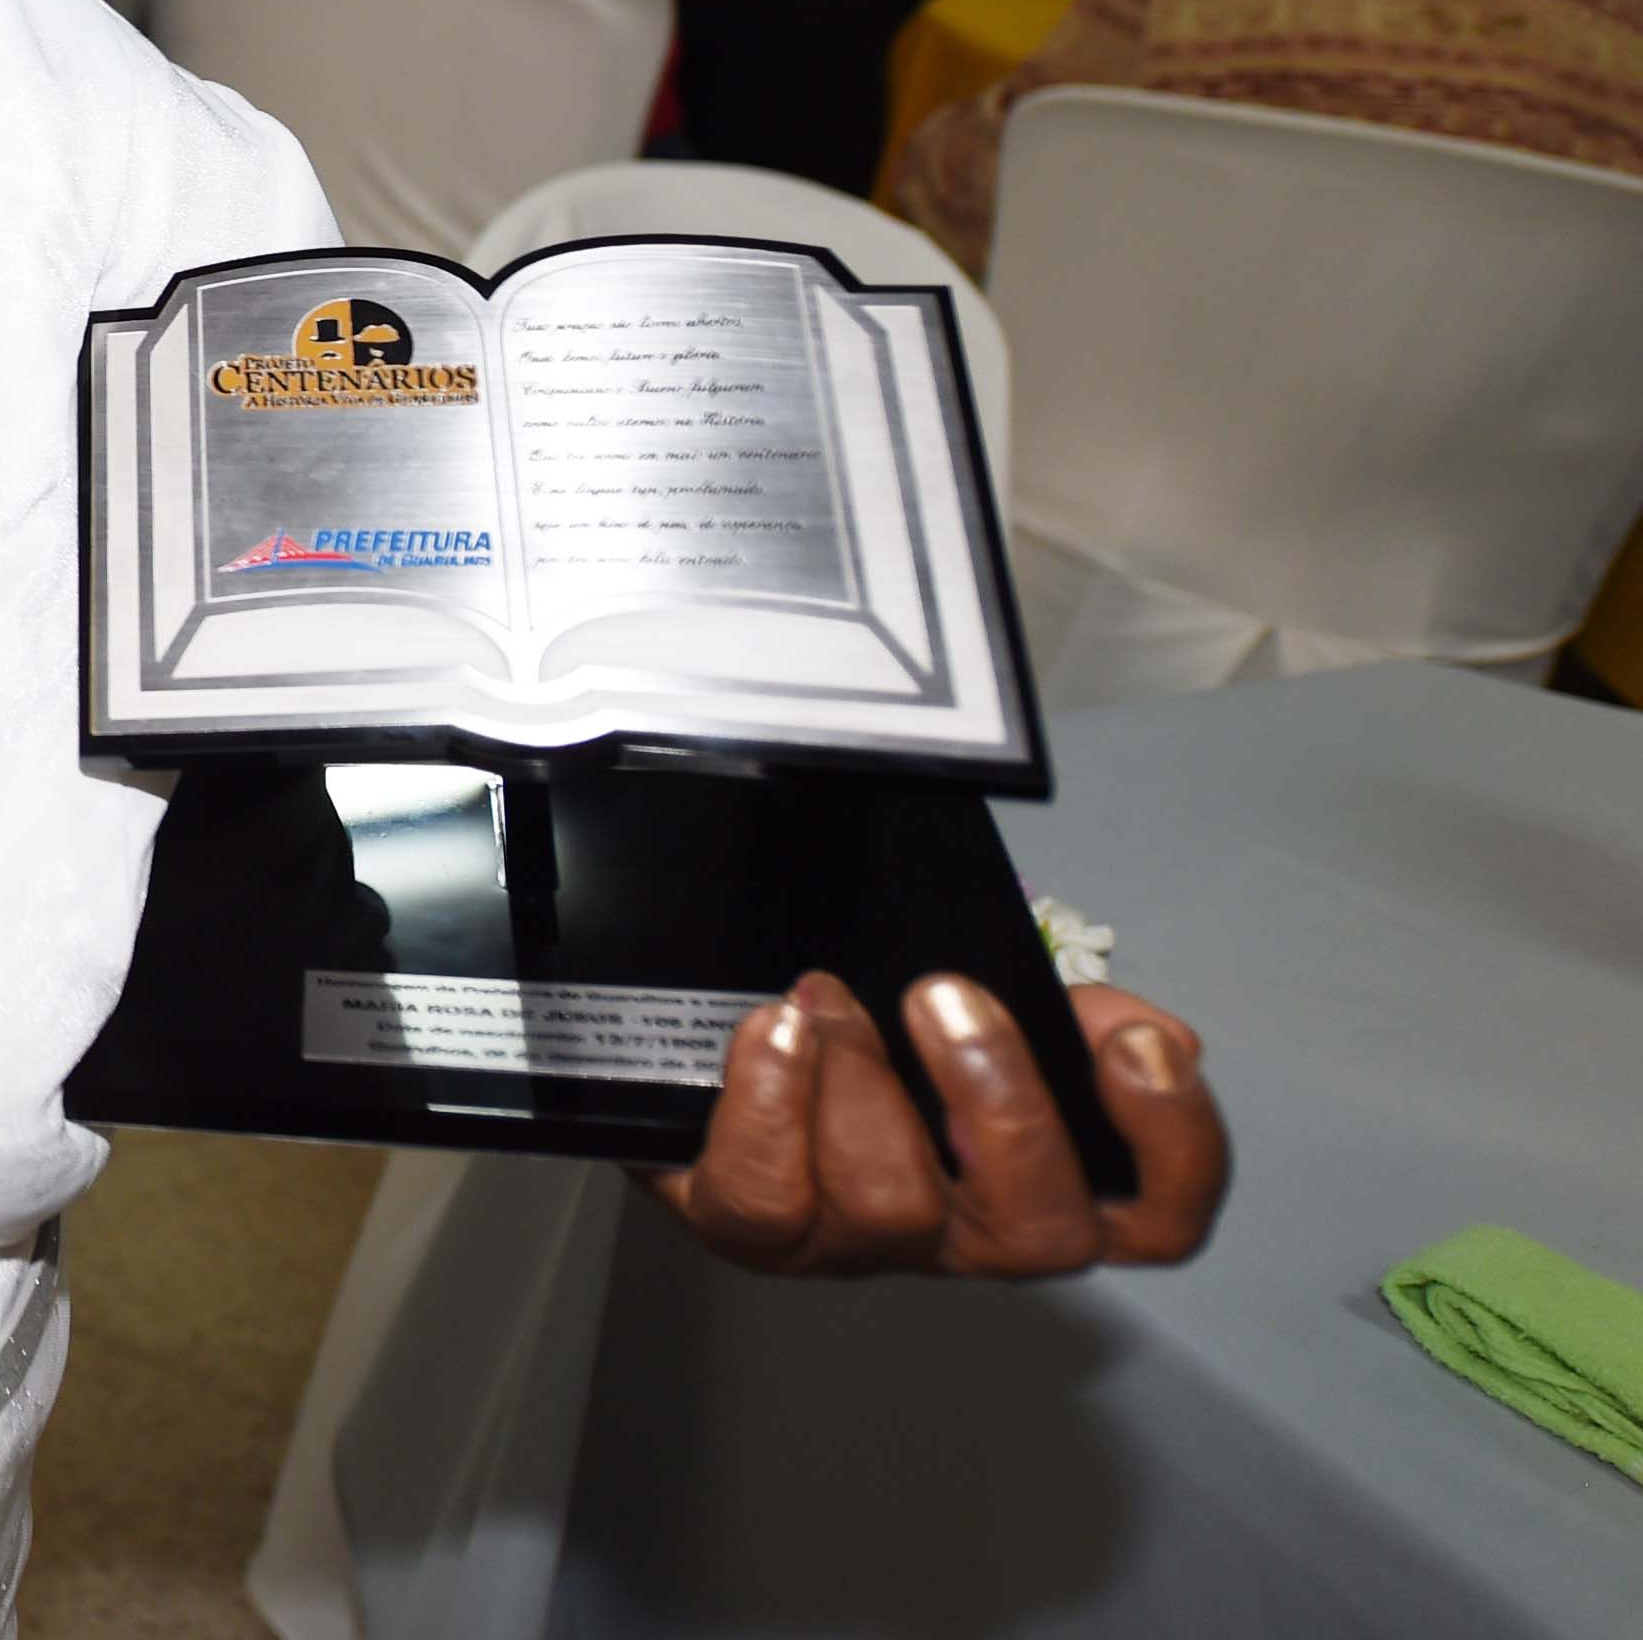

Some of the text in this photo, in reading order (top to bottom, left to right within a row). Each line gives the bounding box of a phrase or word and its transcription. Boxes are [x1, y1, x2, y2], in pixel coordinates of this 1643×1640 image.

[315, 530, 491, 551] PREFEITURA
[341, 997, 419, 1013] MARIA
[426, 1003, 494, 1018] ROSA
